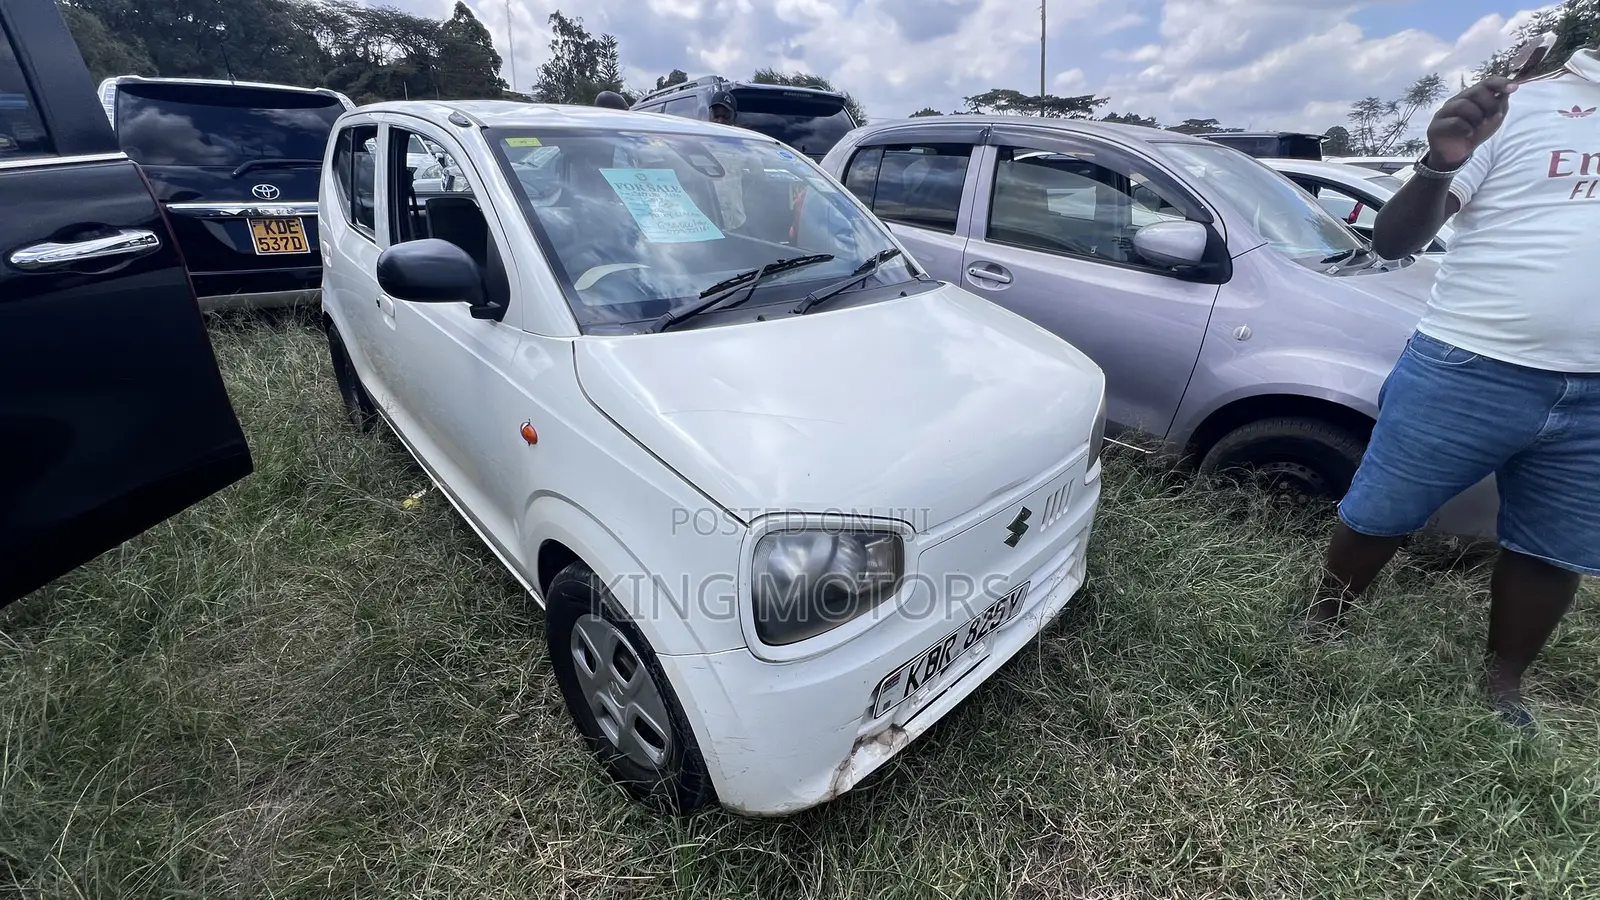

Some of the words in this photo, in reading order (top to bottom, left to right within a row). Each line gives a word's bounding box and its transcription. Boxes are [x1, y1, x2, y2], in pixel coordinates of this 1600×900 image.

[614, 182, 646, 192] FOR
[647, 183, 681, 194] SALE
[263, 219, 298, 235] KDE
[258, 236, 303, 252] 537D
[903, 633, 958, 699] KBR
